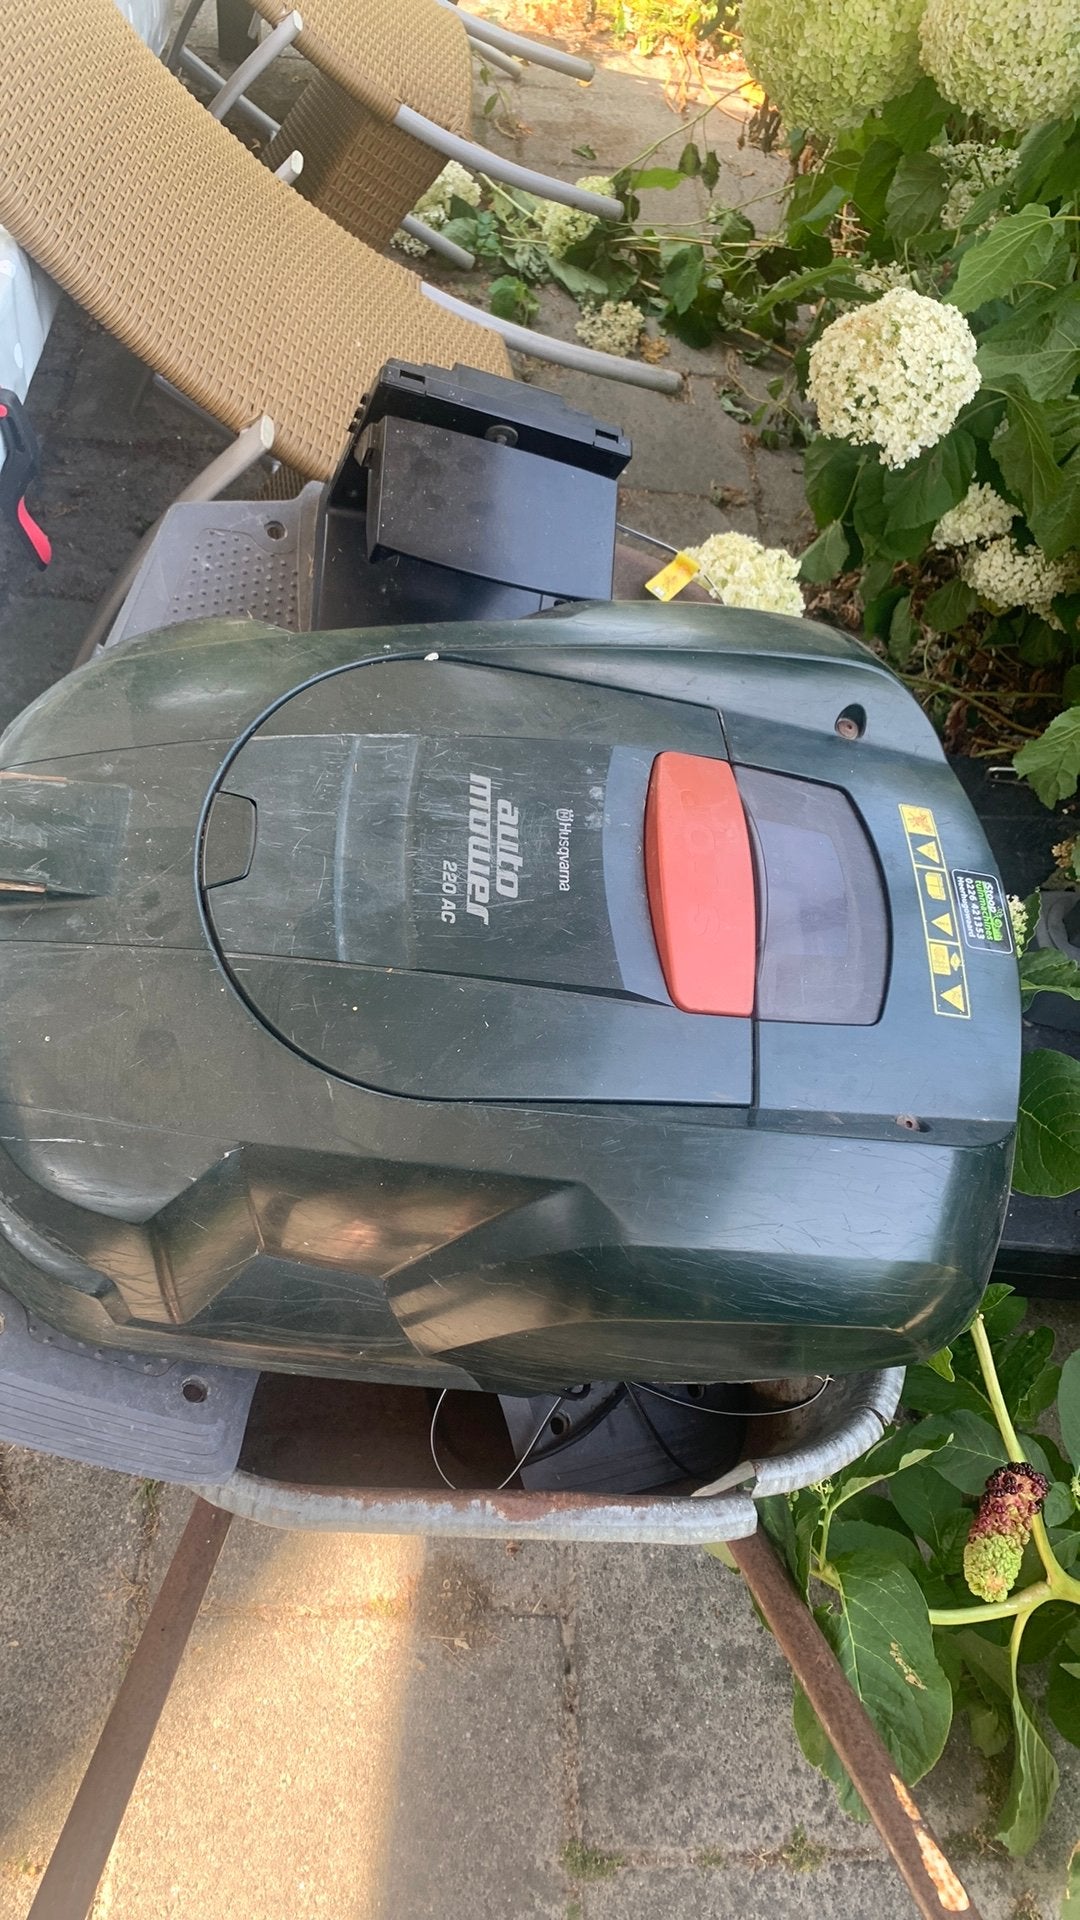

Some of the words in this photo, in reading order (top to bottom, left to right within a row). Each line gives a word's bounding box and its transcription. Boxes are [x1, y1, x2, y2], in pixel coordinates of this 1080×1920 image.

[466, 773, 492, 926] mower
[496, 798, 524, 899] auto
[556, 823, 571, 892] Husqvarna
[441, 860, 457, 895] 220
[965, 877, 978, 901] 0226
[984, 881, 997, 913] Stoop
[440, 897, 457, 924] AC
[957, 876, 976, 938] Heerhugowaard
[971, 902, 985, 940] 421353
[975, 880, 994, 940] tuinmachines
